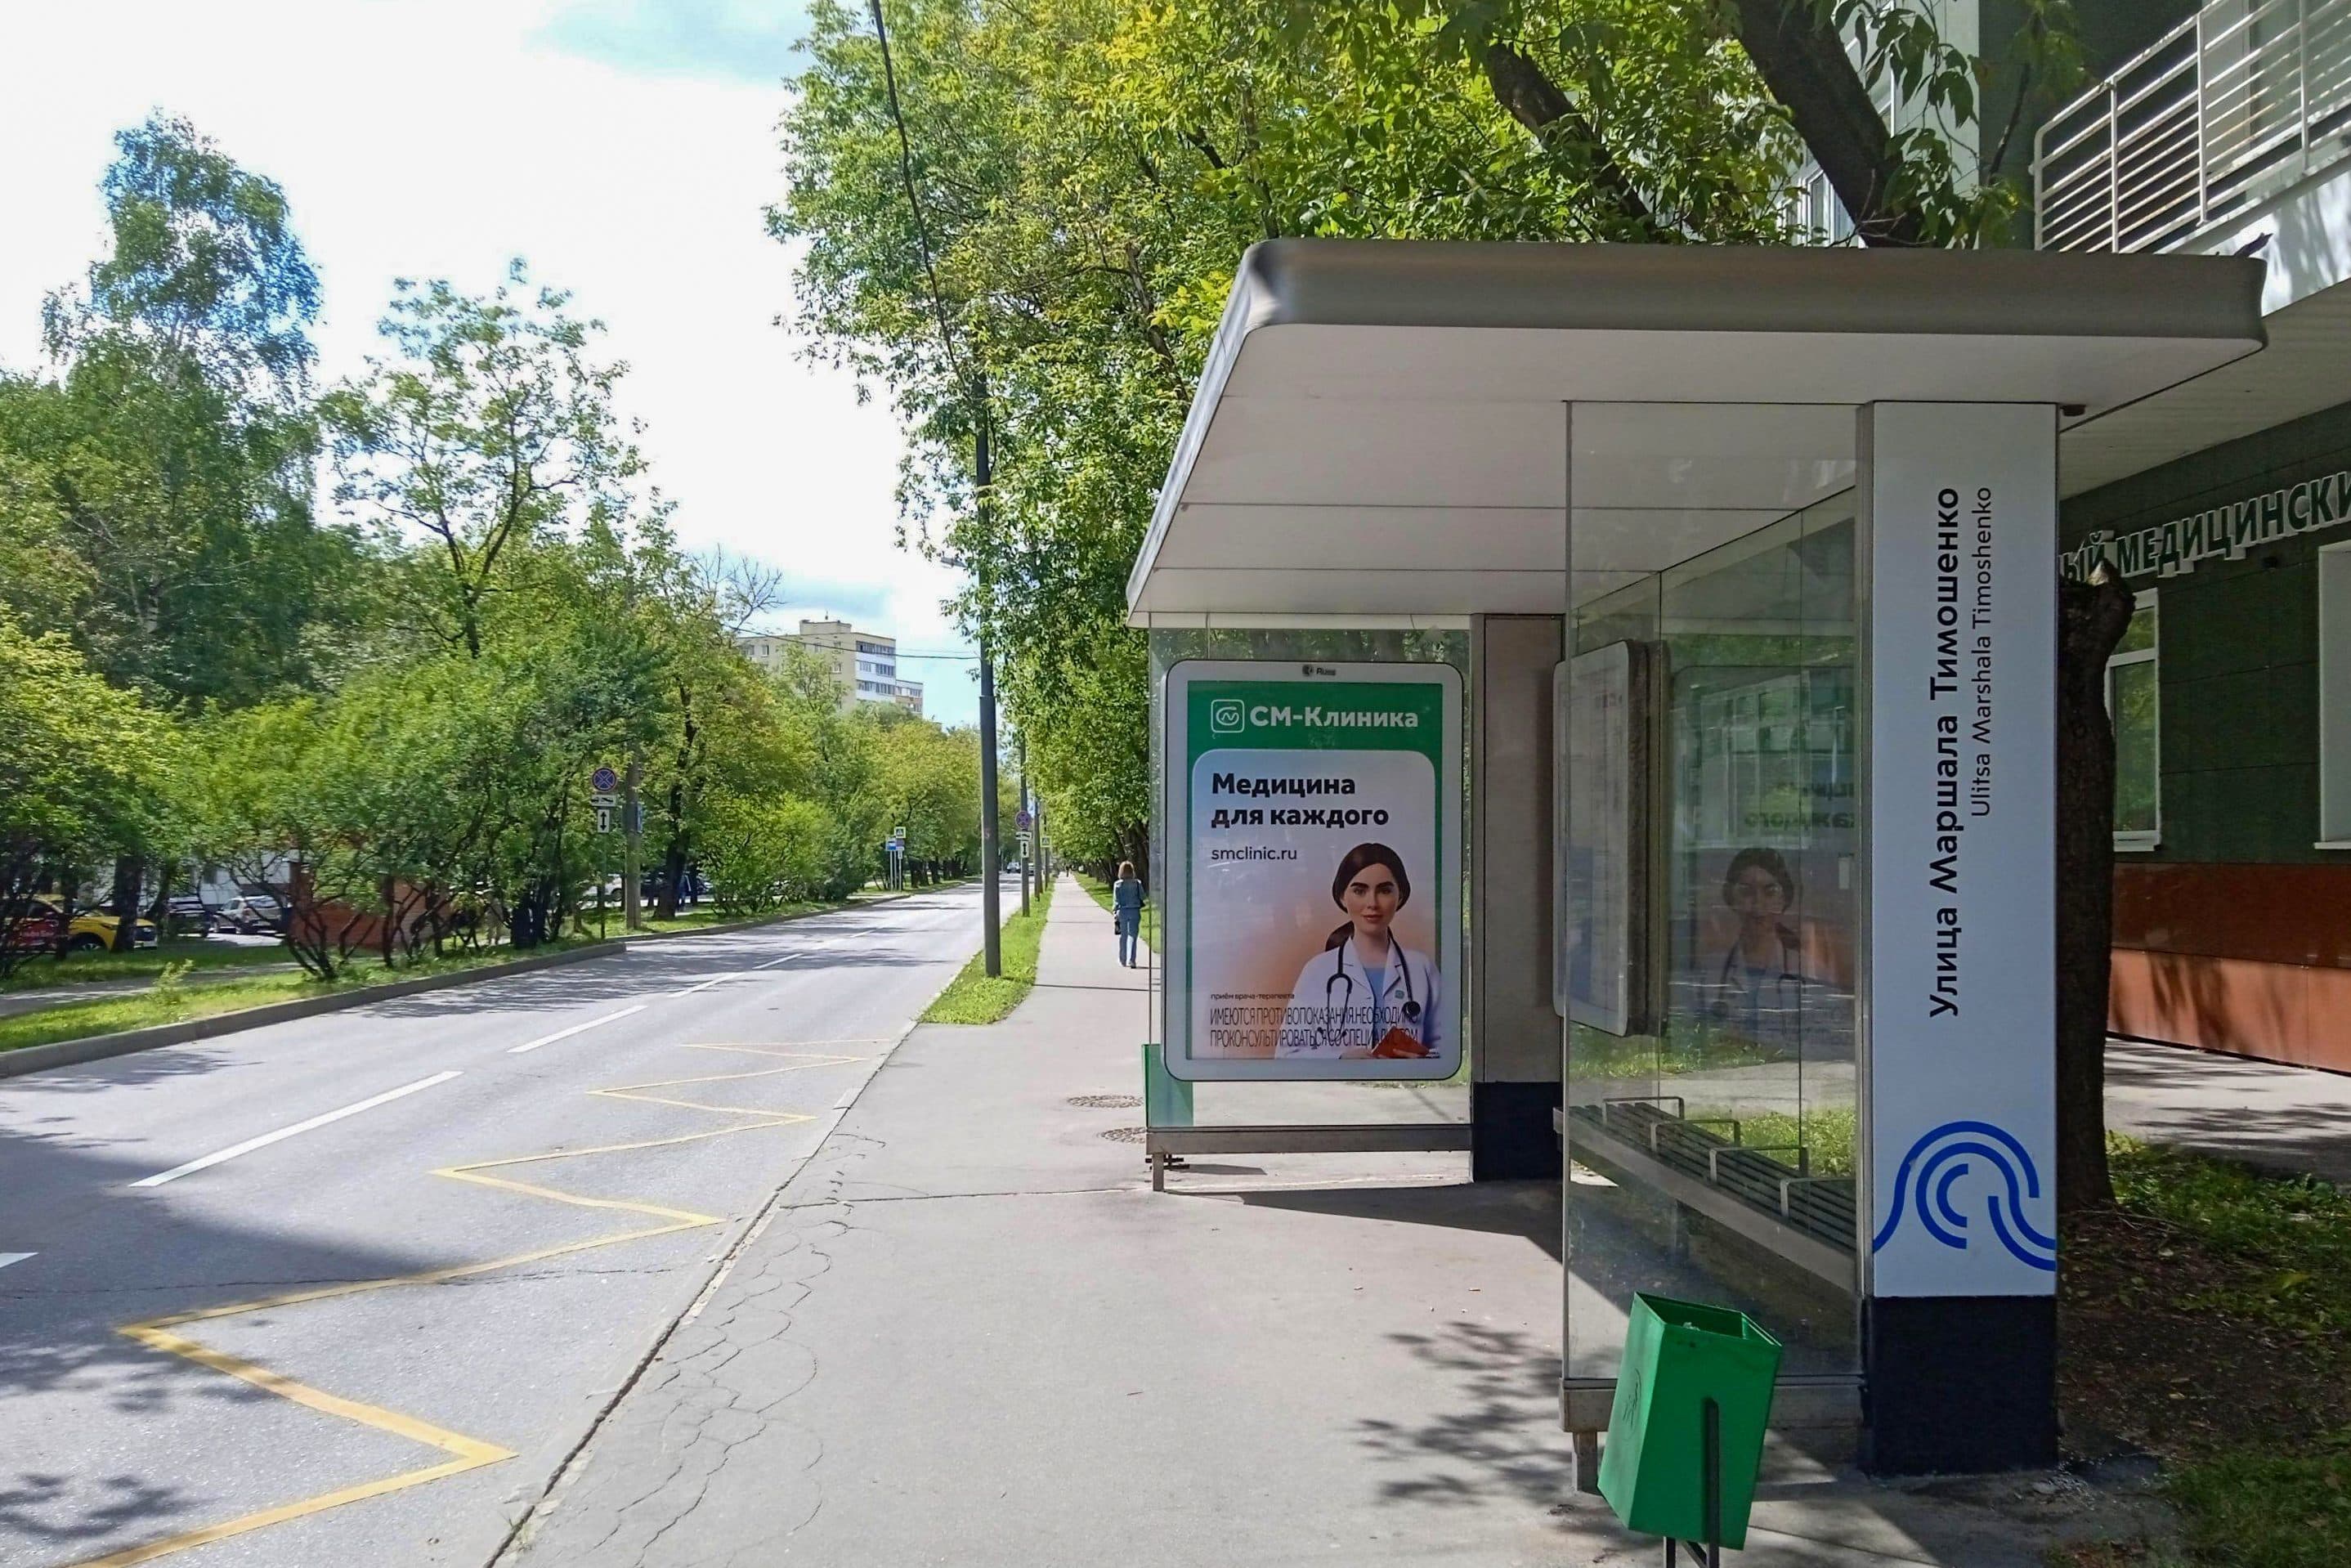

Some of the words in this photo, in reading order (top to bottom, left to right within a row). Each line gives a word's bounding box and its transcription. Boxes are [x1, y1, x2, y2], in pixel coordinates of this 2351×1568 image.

[1971, 486, 1992, 629] Timoshenko
[1929, 487, 1959, 701] Тимошенко
[1971, 635, 1992, 744] Marshala
[1250, 706, 1419, 728] СМ-Клиника
[1211, 773, 1356, 798] Медицина
[1929, 715, 1964, 894] Маршала
[1971, 753, 1991, 817] Ulitsa
[1211, 809, 1264, 828] для
[1270, 809, 1390, 829] каждого
[1211, 846, 1297, 860] smclinic.ru
[1929, 907, 1962, 1018] Улица
[1210, 1006, 1255, 1025] ИМЕЮТСЯ
[1210, 1028, 1327, 1047] ПРОКОНСУЛЬТИРОВАТЬСЯ
[1343, 1028, 1417, 1046] СПЕЦИАЛТОМ
